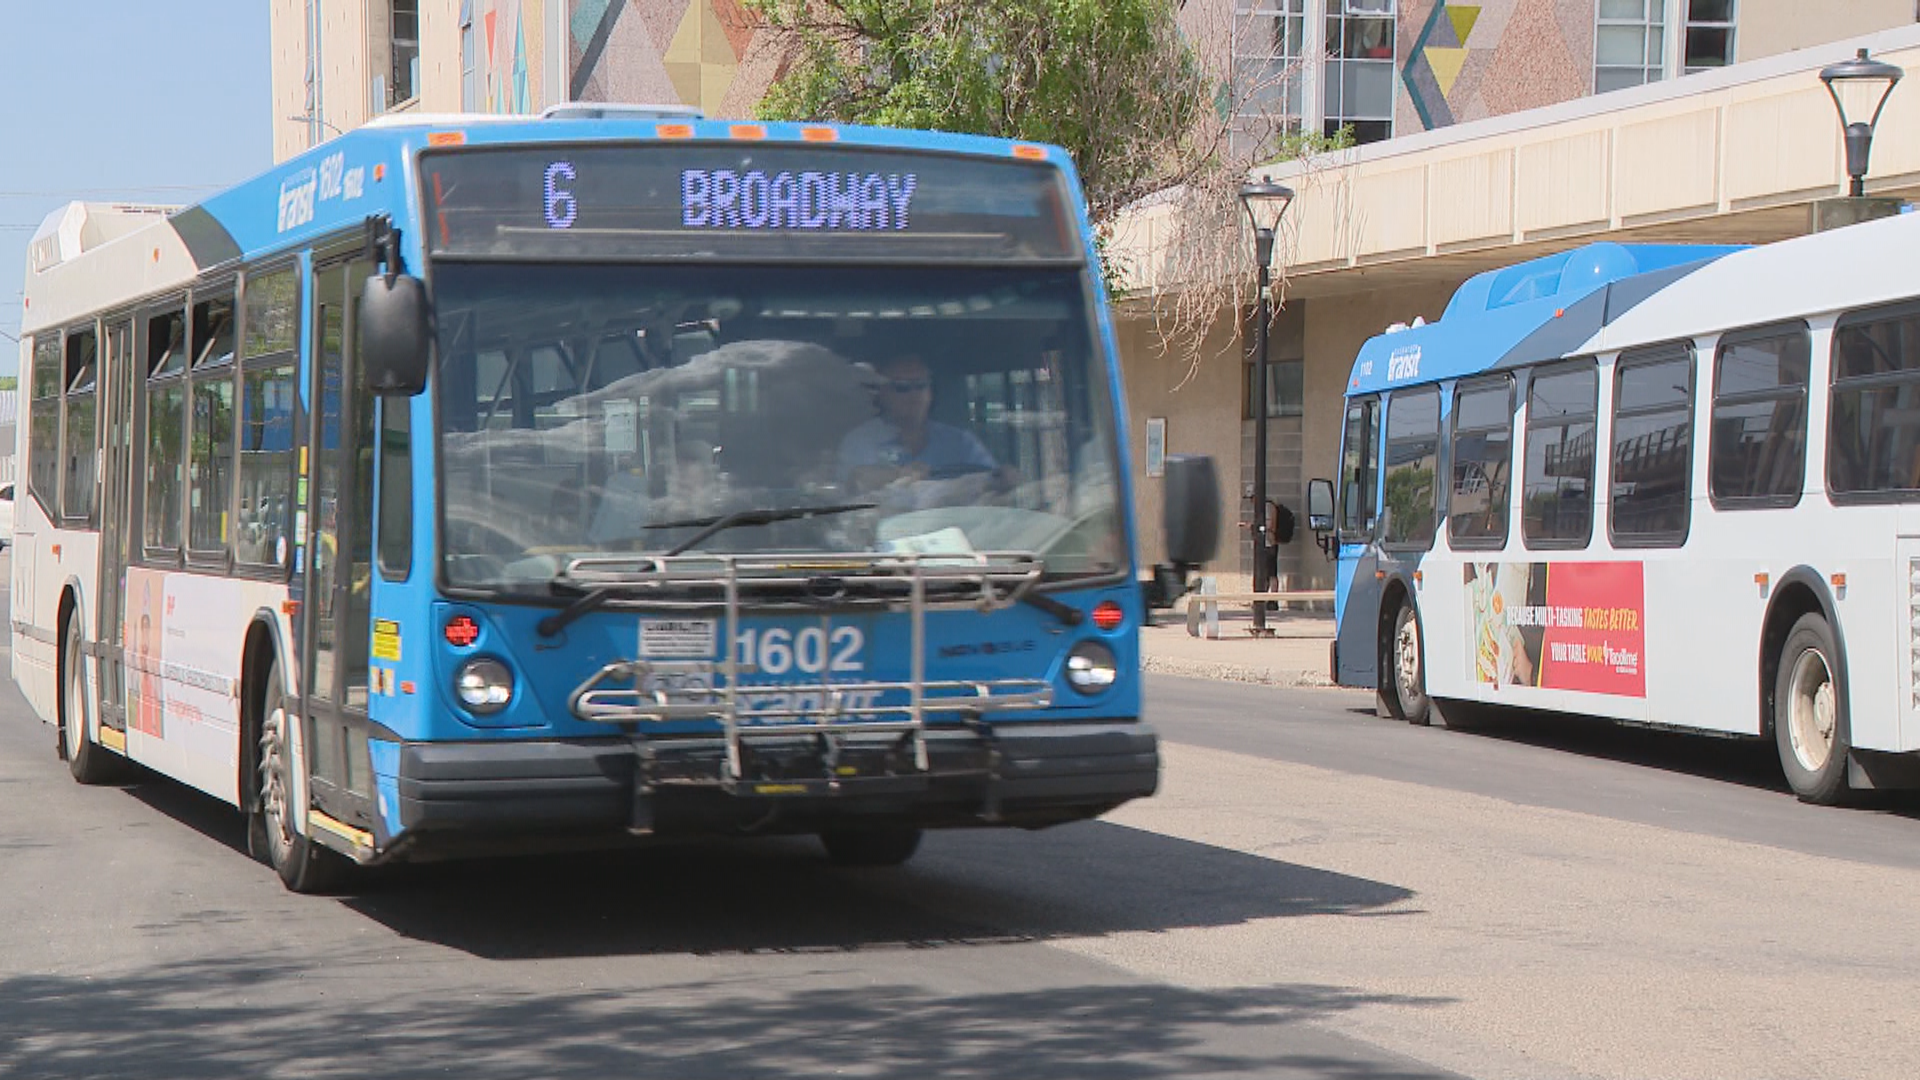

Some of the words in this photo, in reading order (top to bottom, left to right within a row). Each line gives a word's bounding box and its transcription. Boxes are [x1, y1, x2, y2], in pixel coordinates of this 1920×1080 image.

[543, 161, 577, 229] 6
[681, 168, 917, 229] BROADWAY
[1387, 345, 1422, 382] transit
[1535, 606, 1583, 628] MULTI-TASKING
[1583, 607, 1609, 630] TASTES
[736, 625, 864, 675] 1602
[1550, 642, 1568, 661] YOUR
[1567, 644, 1587, 663] TABLE
